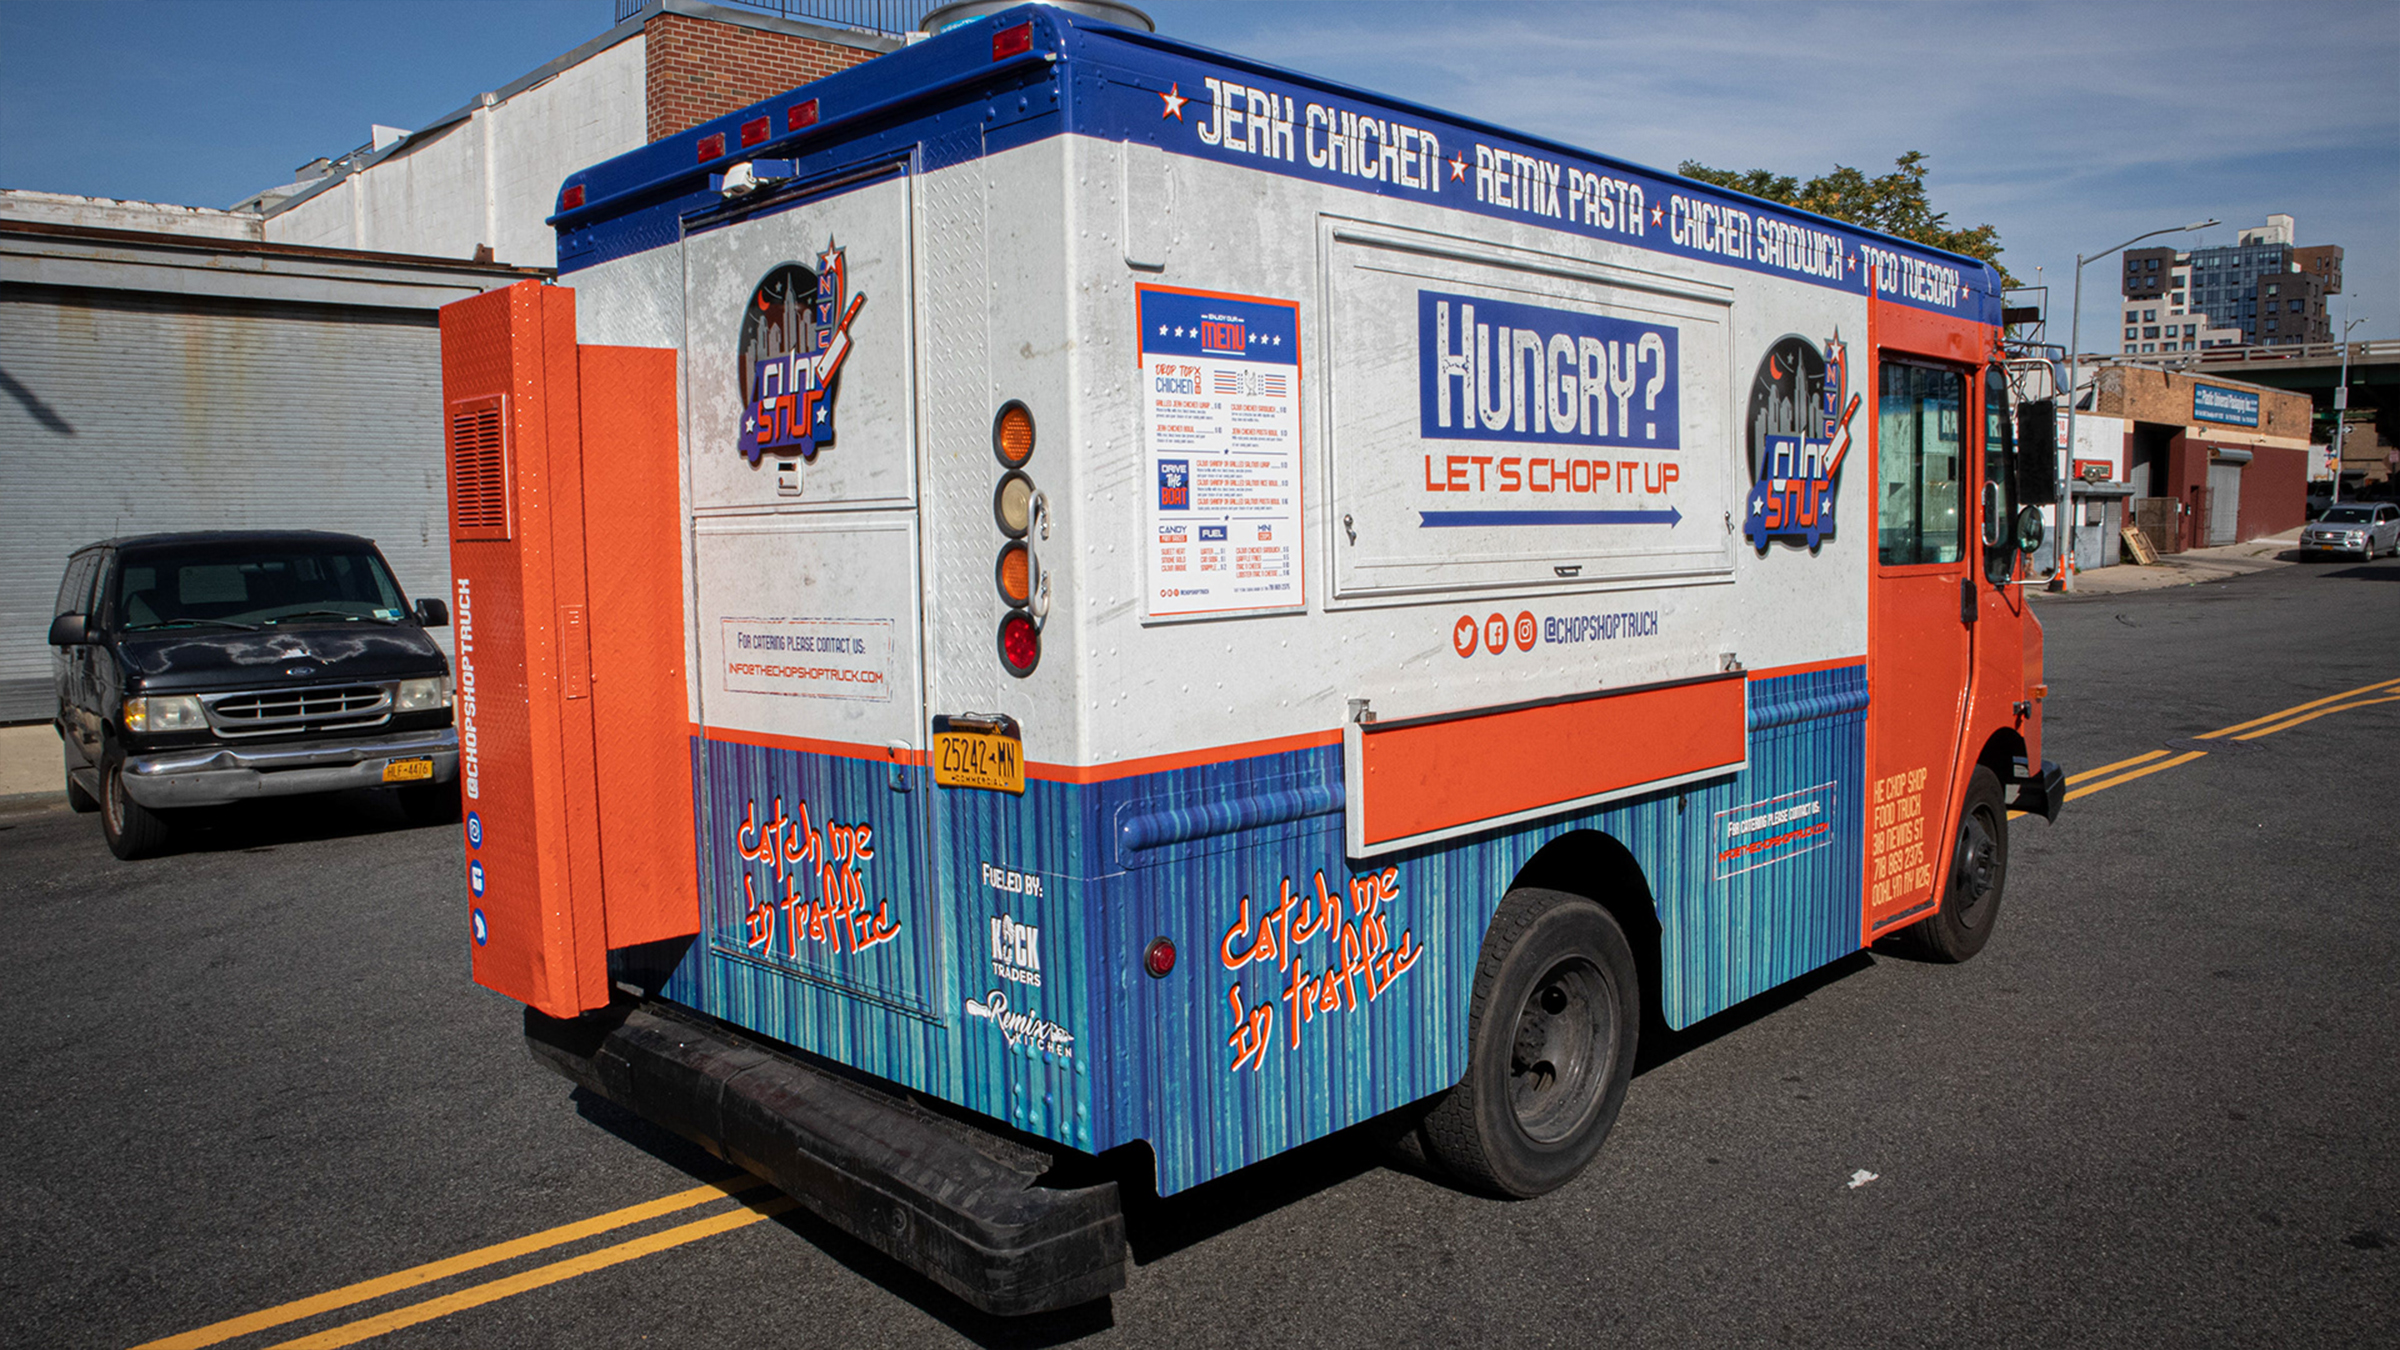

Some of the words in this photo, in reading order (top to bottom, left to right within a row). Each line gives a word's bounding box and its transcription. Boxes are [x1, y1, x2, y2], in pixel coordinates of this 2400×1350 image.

[1197, 77, 1294, 163] JERK
[1305, 103, 1440, 193] CHICKEN
[1475, 143, 1561, 219] REMIX
[1568, 167, 1644, 237] PASTA
[1670, 194, 1752, 260] CHICKEN
[1756, 216, 1843, 281] SANDWICH
[1900, 255, 1959, 308] TUESDAY
[1201, 321, 1246, 351] MENU
[1437, 301, 1665, 439] HUNGRY?
[1155, 377, 1194, 395] CHICKEN
[1161, 464, 1187, 473] DRIVE
[1166, 473, 1181, 488] THE
[1425, 454, 1521, 492] LET'S
[1528, 457, 1610, 494] CHOP
[1616, 461, 1639, 494] IT
[1644, 462, 1680, 495] UP
[1162, 487, 1187, 505] BOAT
[1159, 525, 1187, 534] CANDY
[1202, 529, 1224, 537] FUEL
[1544, 610, 1658, 644] @CHOPSHOPTRUCK
[737, 631, 751, 649] FOR
[753, 634, 785, 651] CATERING
[787, 636, 814, 652] PLEASE
[816, 637, 850, 654] CONTACT
[729, 662, 883, 683] INFO@THECHOPSHOPTRUCK.COM
[1908, 767, 1927, 793] SHOP
[1741, 815, 1767, 834] CATERING
[1768, 809, 1788, 826] PLEASE
[1789, 803, 1811, 820] CONTACT
[1875, 801, 1896, 831] FOOD
[1897, 793, 1921, 822] TRUCK
[1914, 816, 1925, 840] ST
[982, 861, 1022, 893] FUELED
[1025, 874, 1043, 897] BY:
[992, 961, 1041, 987] TRADERS
[986, 989, 1050, 1044] Remix
[1014, 1033, 1073, 1057] KITCHEN
